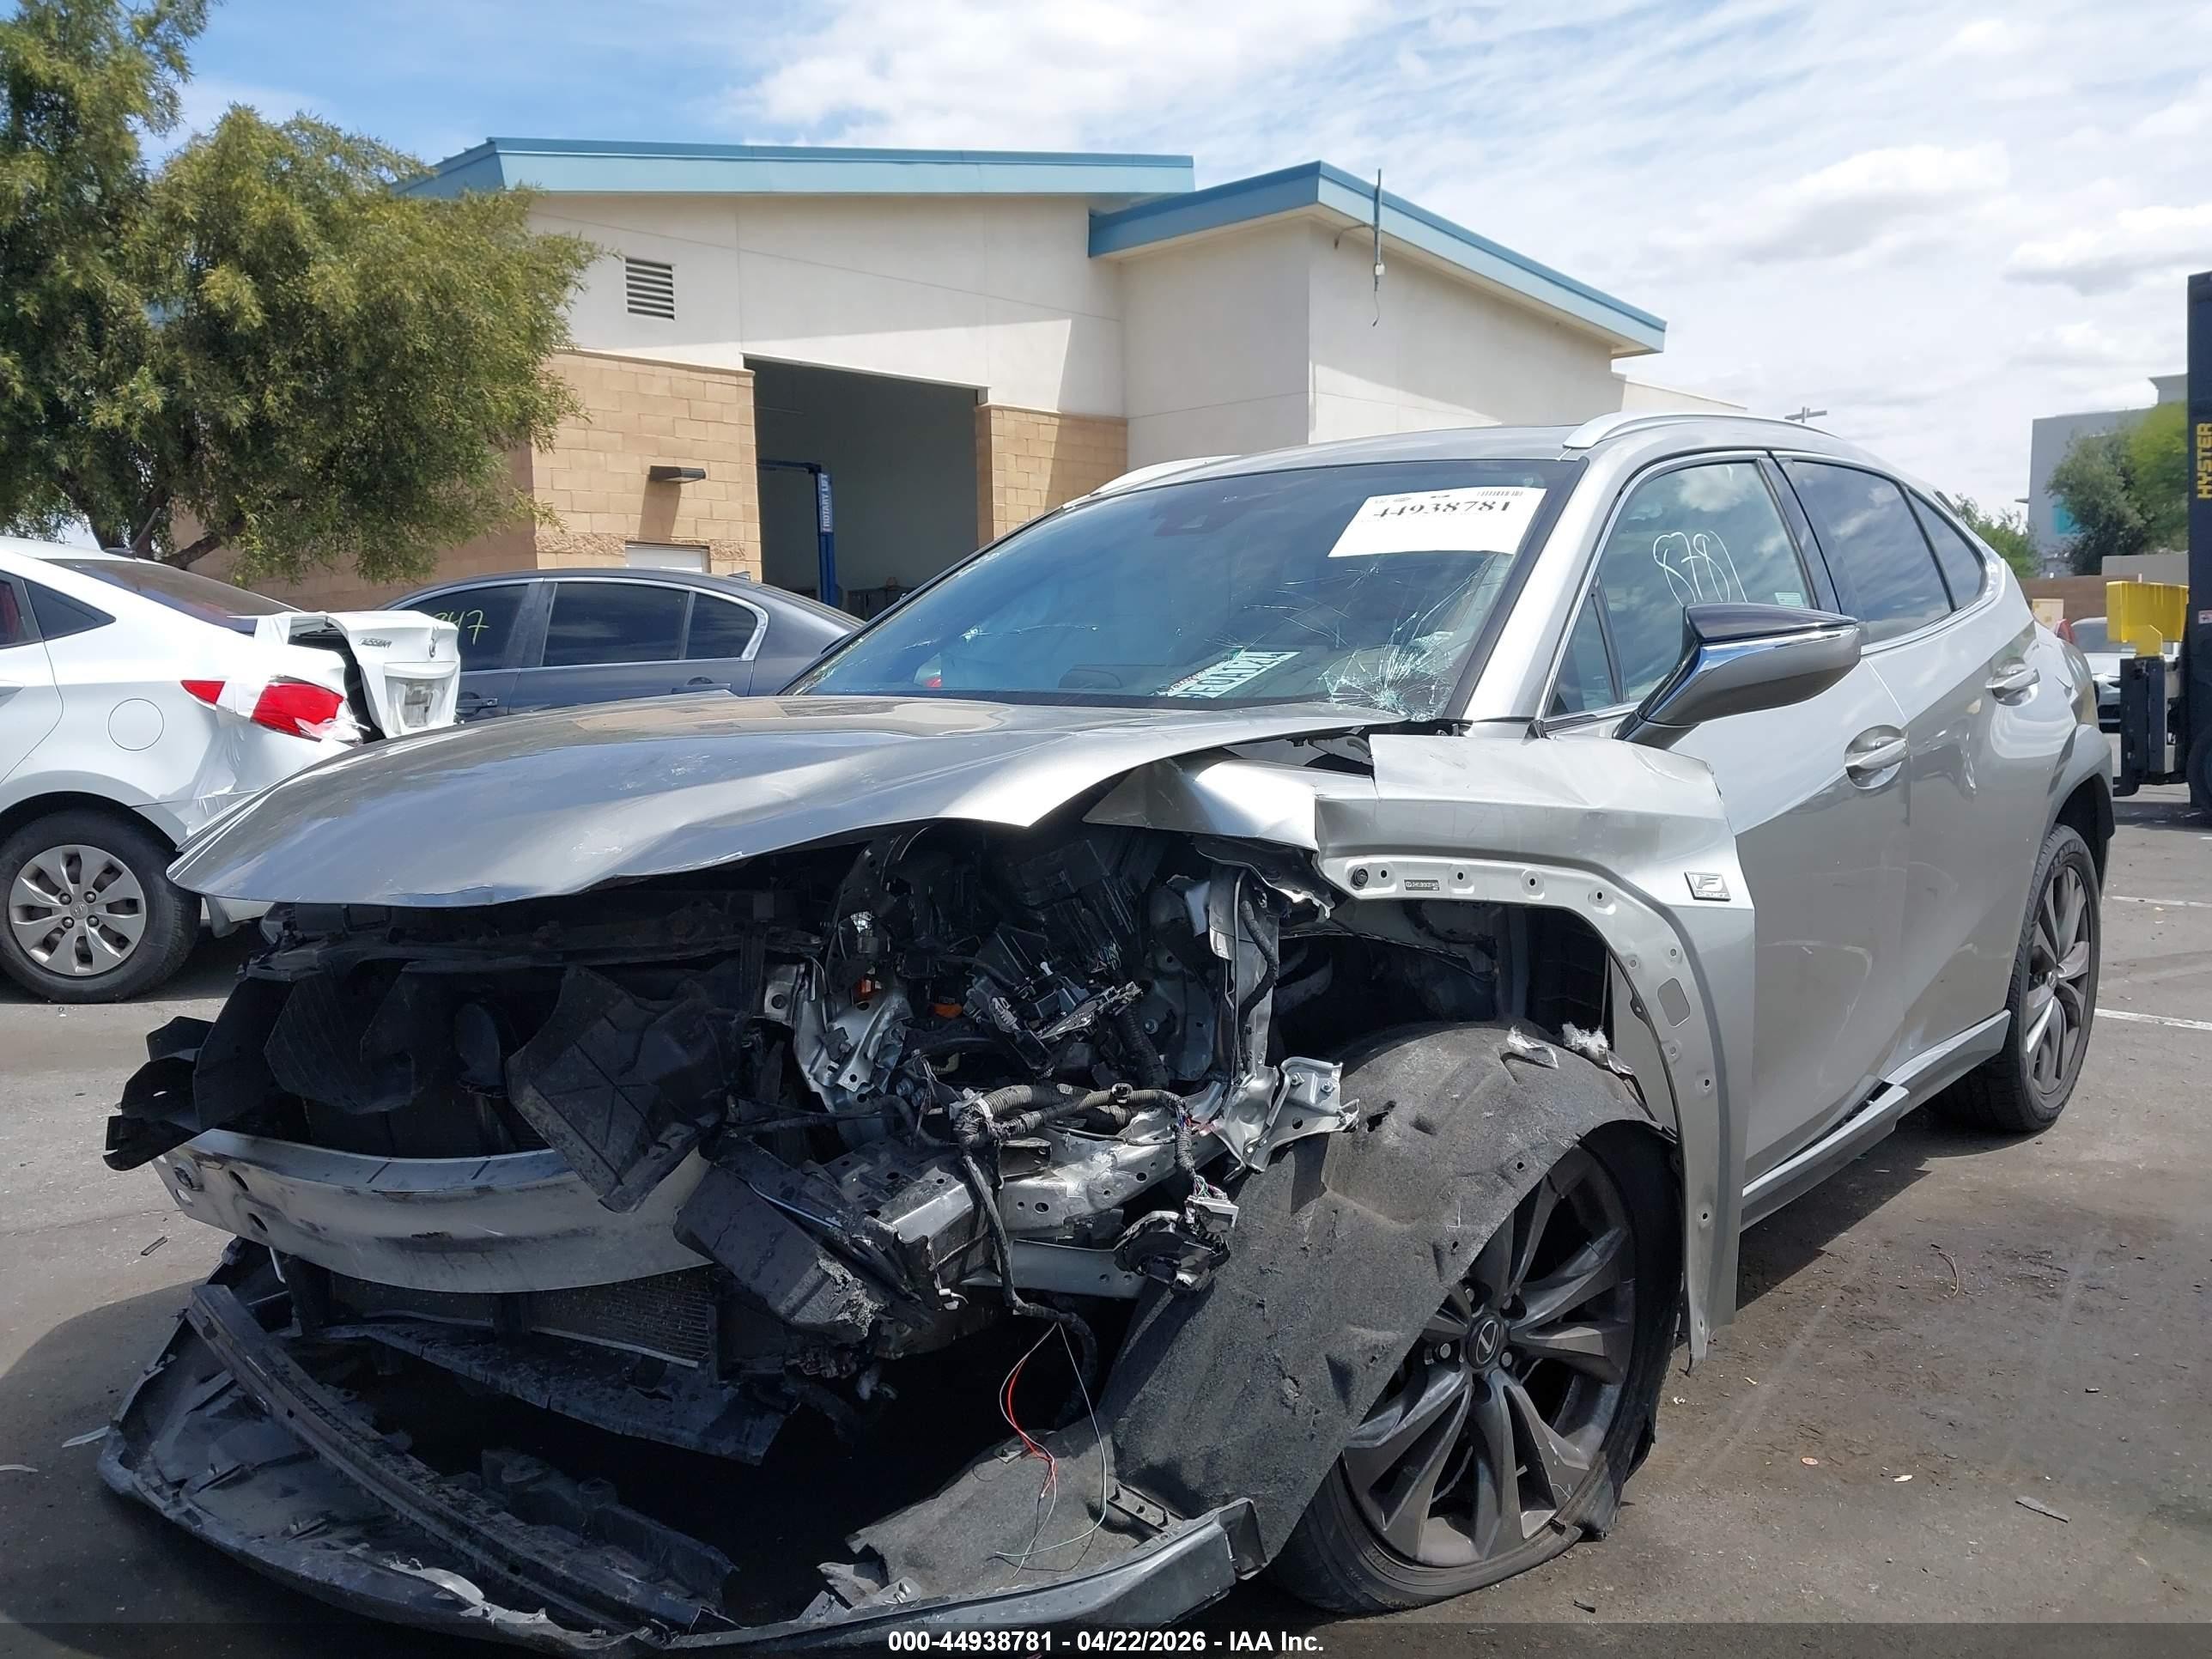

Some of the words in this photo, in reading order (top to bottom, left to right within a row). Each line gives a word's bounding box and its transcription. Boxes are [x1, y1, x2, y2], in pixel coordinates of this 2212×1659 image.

[2197, 422, 2212, 500] HYSTER
[821, 474, 830, 492] LIFT
[822, 495, 831, 528] ROTARY
[1373, 501, 1513, 519] 44938781
